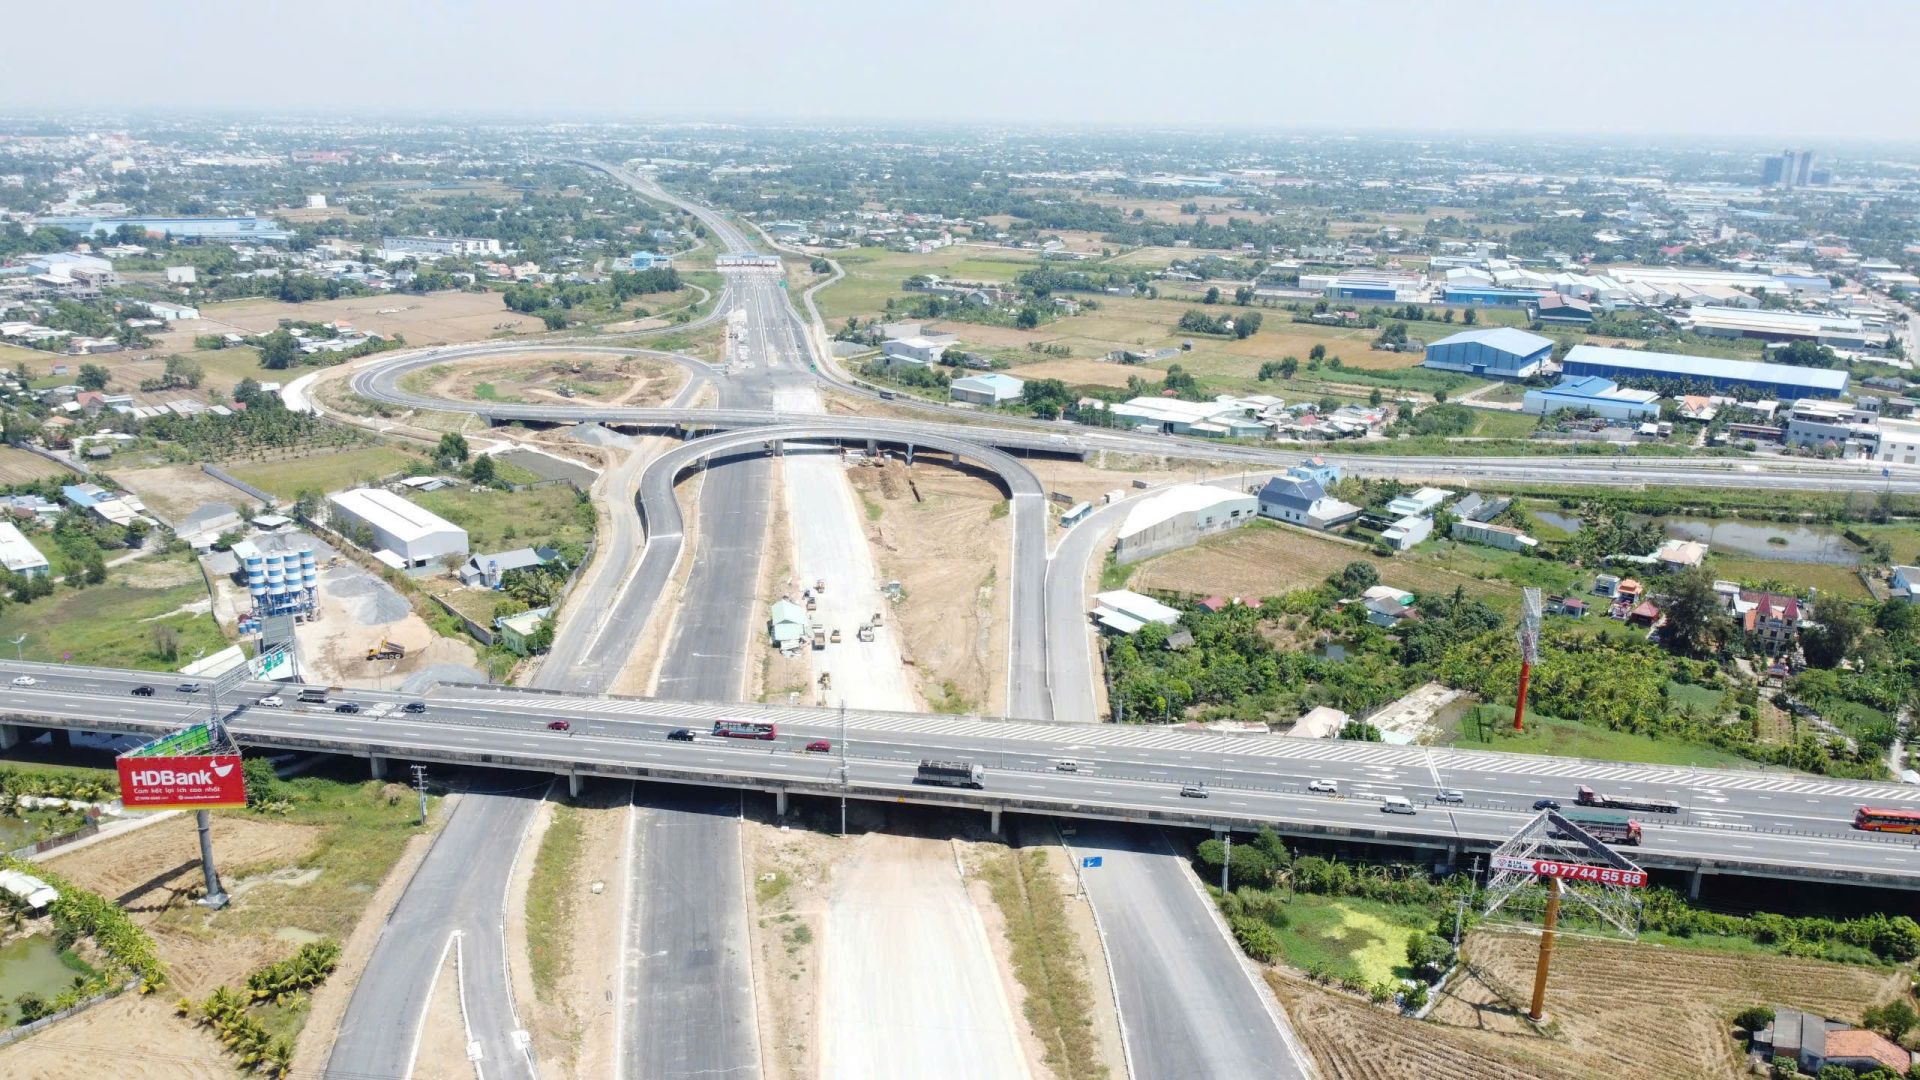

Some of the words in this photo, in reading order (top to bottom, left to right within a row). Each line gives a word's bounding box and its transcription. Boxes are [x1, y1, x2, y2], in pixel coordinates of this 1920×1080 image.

[131, 770, 213, 786] HDBank
[1540, 863, 1558, 875] 09
[1560, 866, 1578, 876] 77
[1580, 868, 1598, 879] 44
[1601, 870, 1619, 882] 55
[1622, 873, 1641, 885] 88
